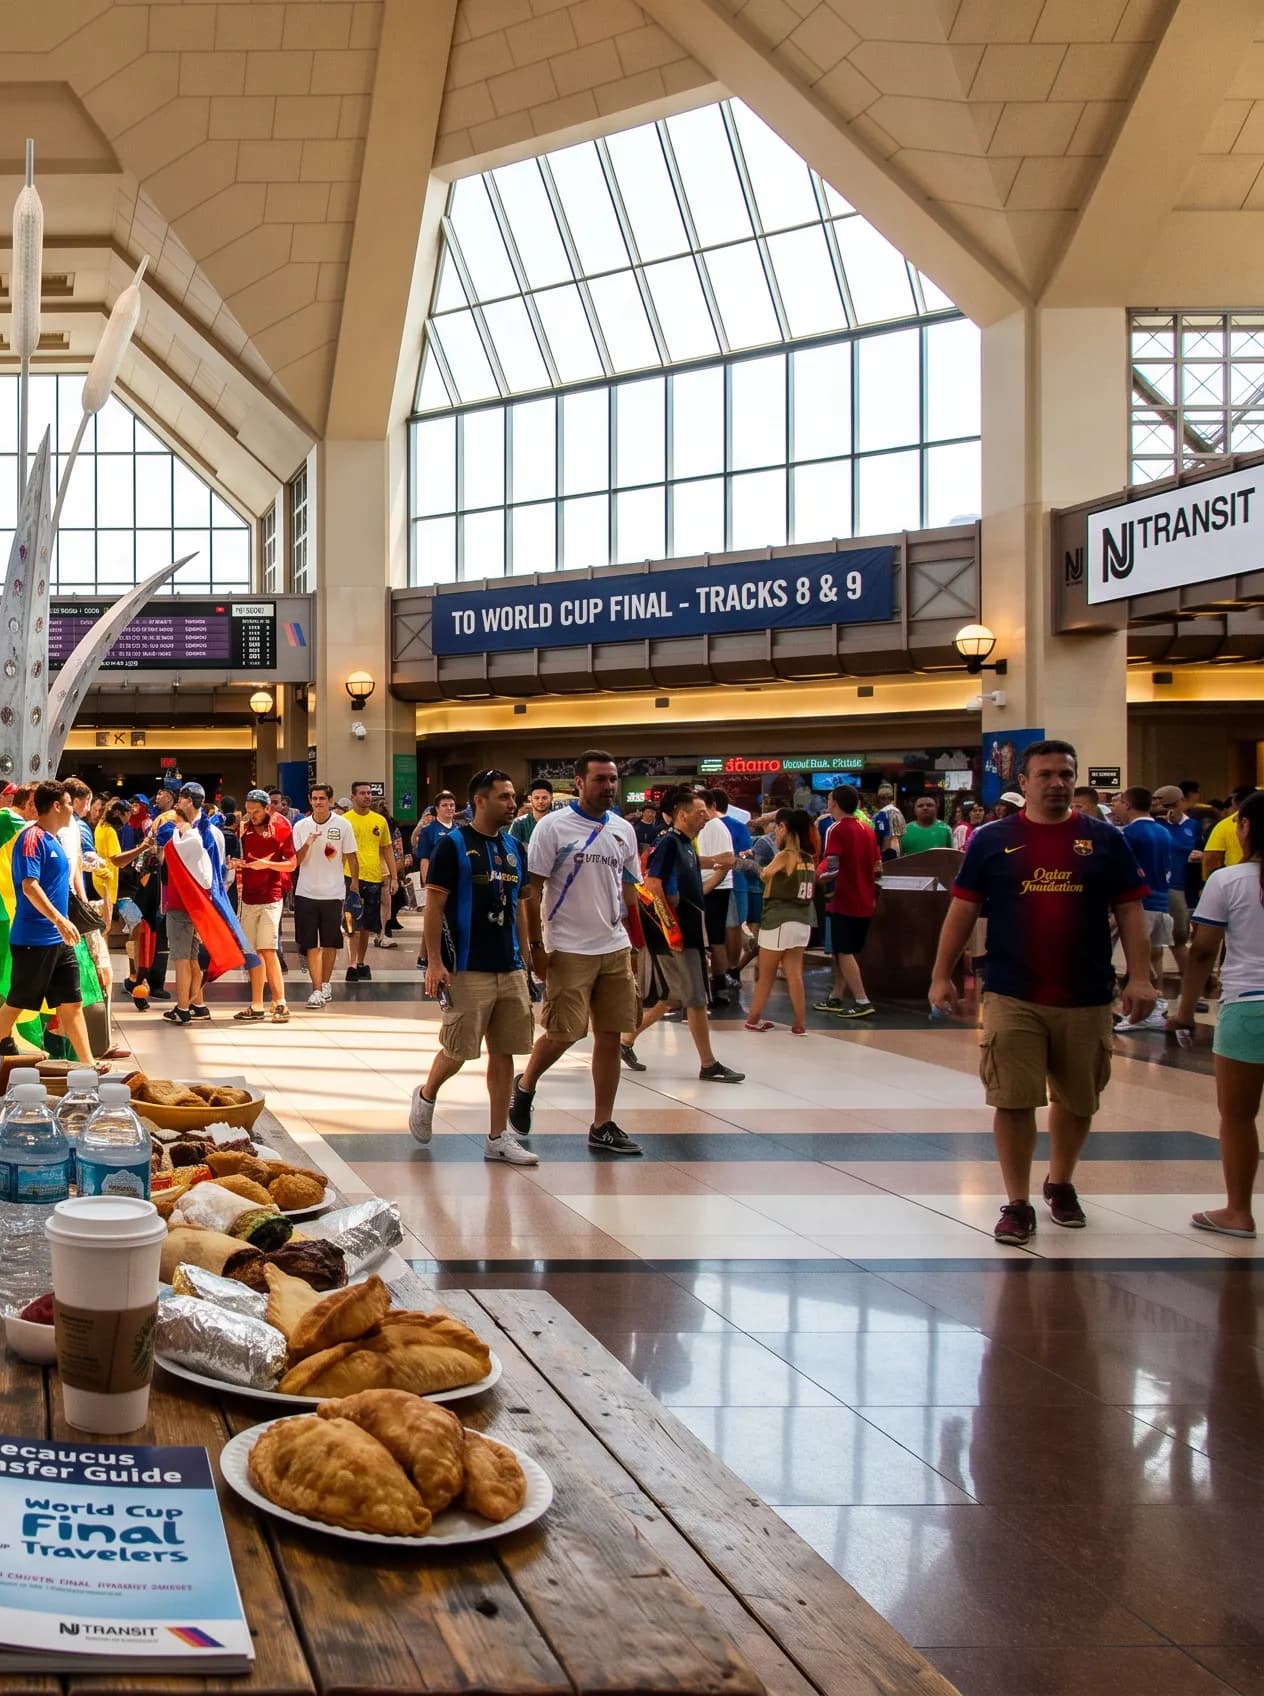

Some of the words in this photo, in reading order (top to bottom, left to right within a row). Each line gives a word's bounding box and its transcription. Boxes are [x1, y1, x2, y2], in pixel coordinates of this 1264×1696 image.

[1102, 520, 1135, 583] NJ
[1137, 487, 1256, 549] TRANSIT
[451, 609, 476, 635] TO
[481, 602, 553, 633] WORLD
[560, 598, 603, 626] CUP
[609, 591, 673, 622] FINAL
[695, 579, 788, 614] TRACKS
[796, 576, 810, 605] 8
[819, 574, 838, 603] &
[846, 570, 862, 600] 9
[1031, 867, 1073, 884] Qatar
[84, 1466, 183, 1484] Guide
[25, 1497, 114, 1517] World
[125, 1505, 184, 1521] Cup
[22, 1513, 185, 1545] Final
[21, 1540, 189, 1563] Travelers
[59, 1622, 80, 1635] NJ
[82, 1624, 158, 1636] TRANSIT
